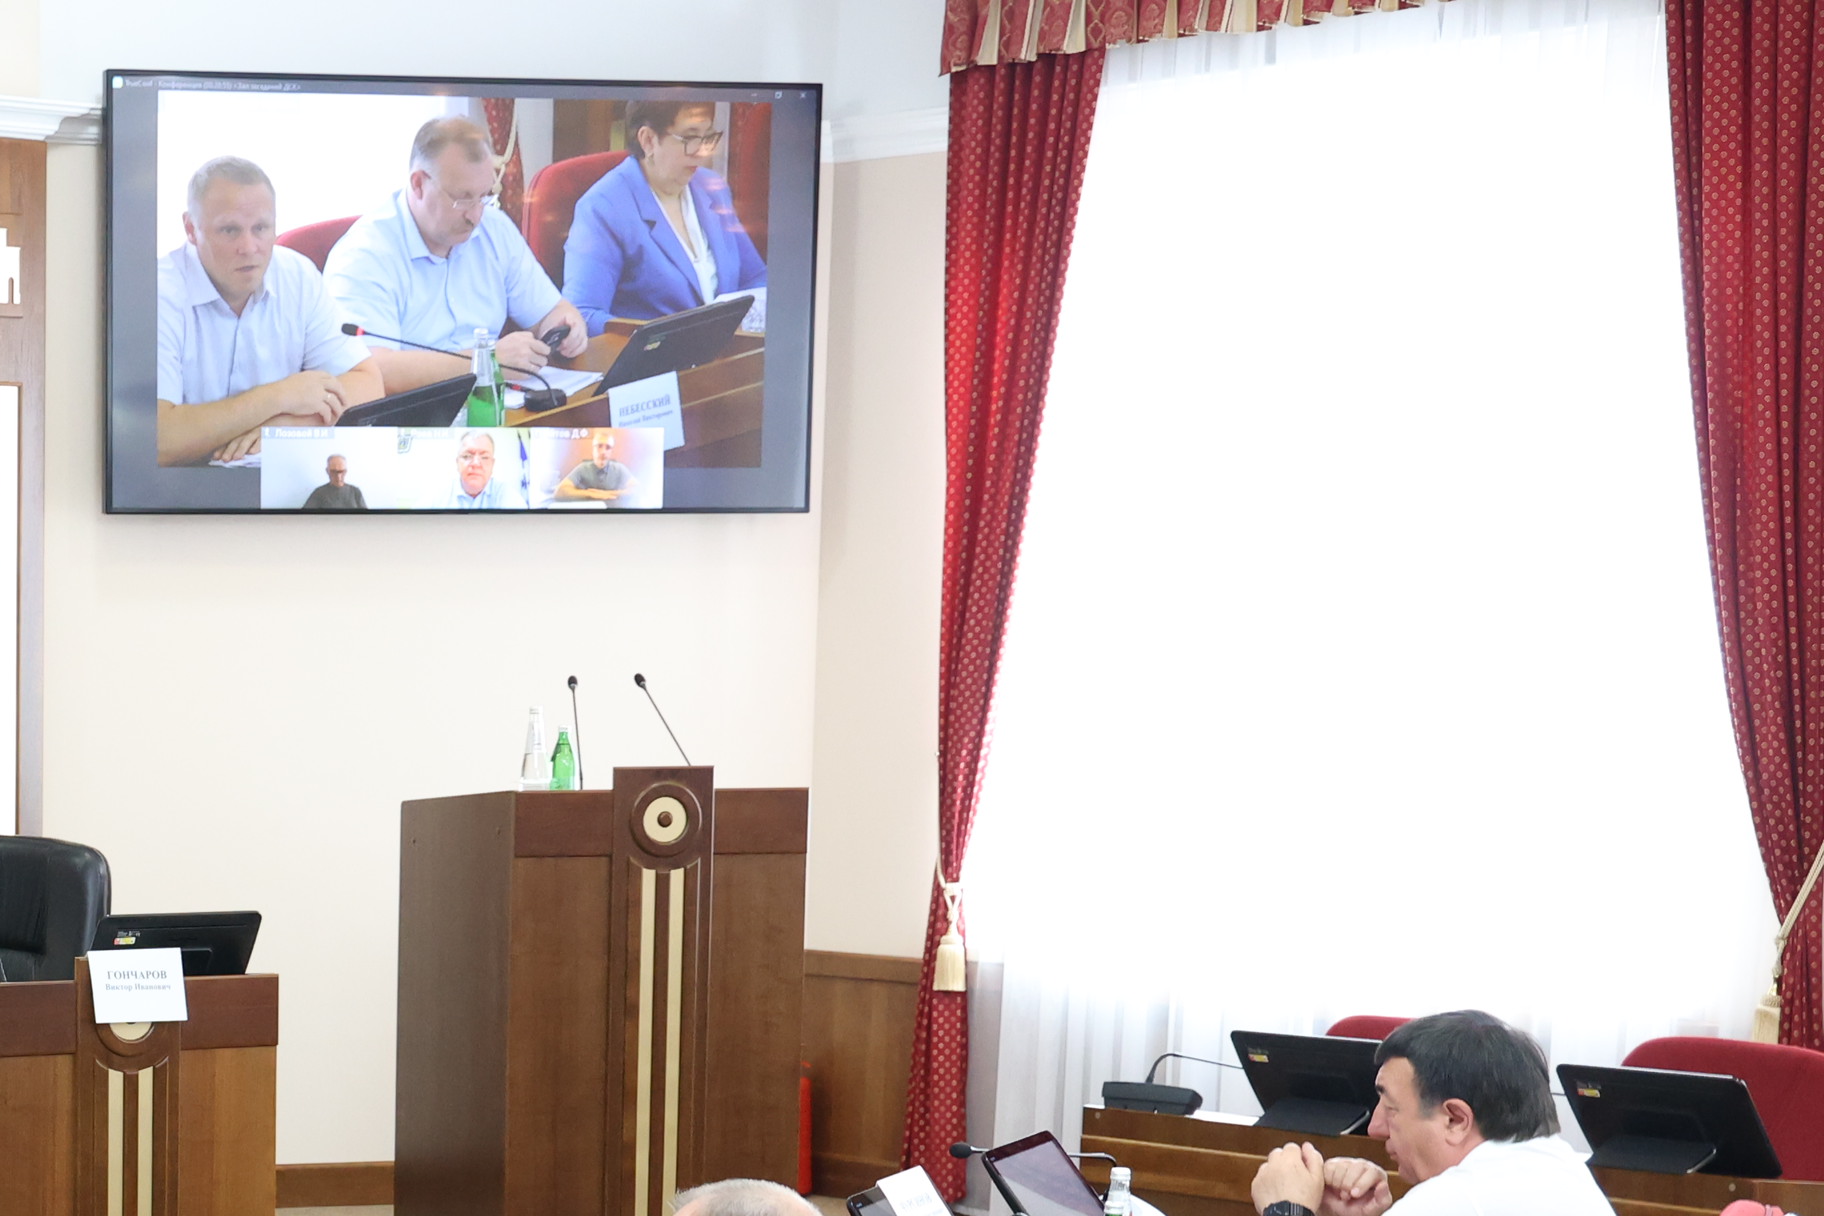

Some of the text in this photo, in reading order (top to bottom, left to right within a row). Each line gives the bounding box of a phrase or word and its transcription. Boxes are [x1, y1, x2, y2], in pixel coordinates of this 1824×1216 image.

[107, 970, 168, 980] ГОНЧАРОВ
[105, 983, 171, 992] Виктор Иванович
